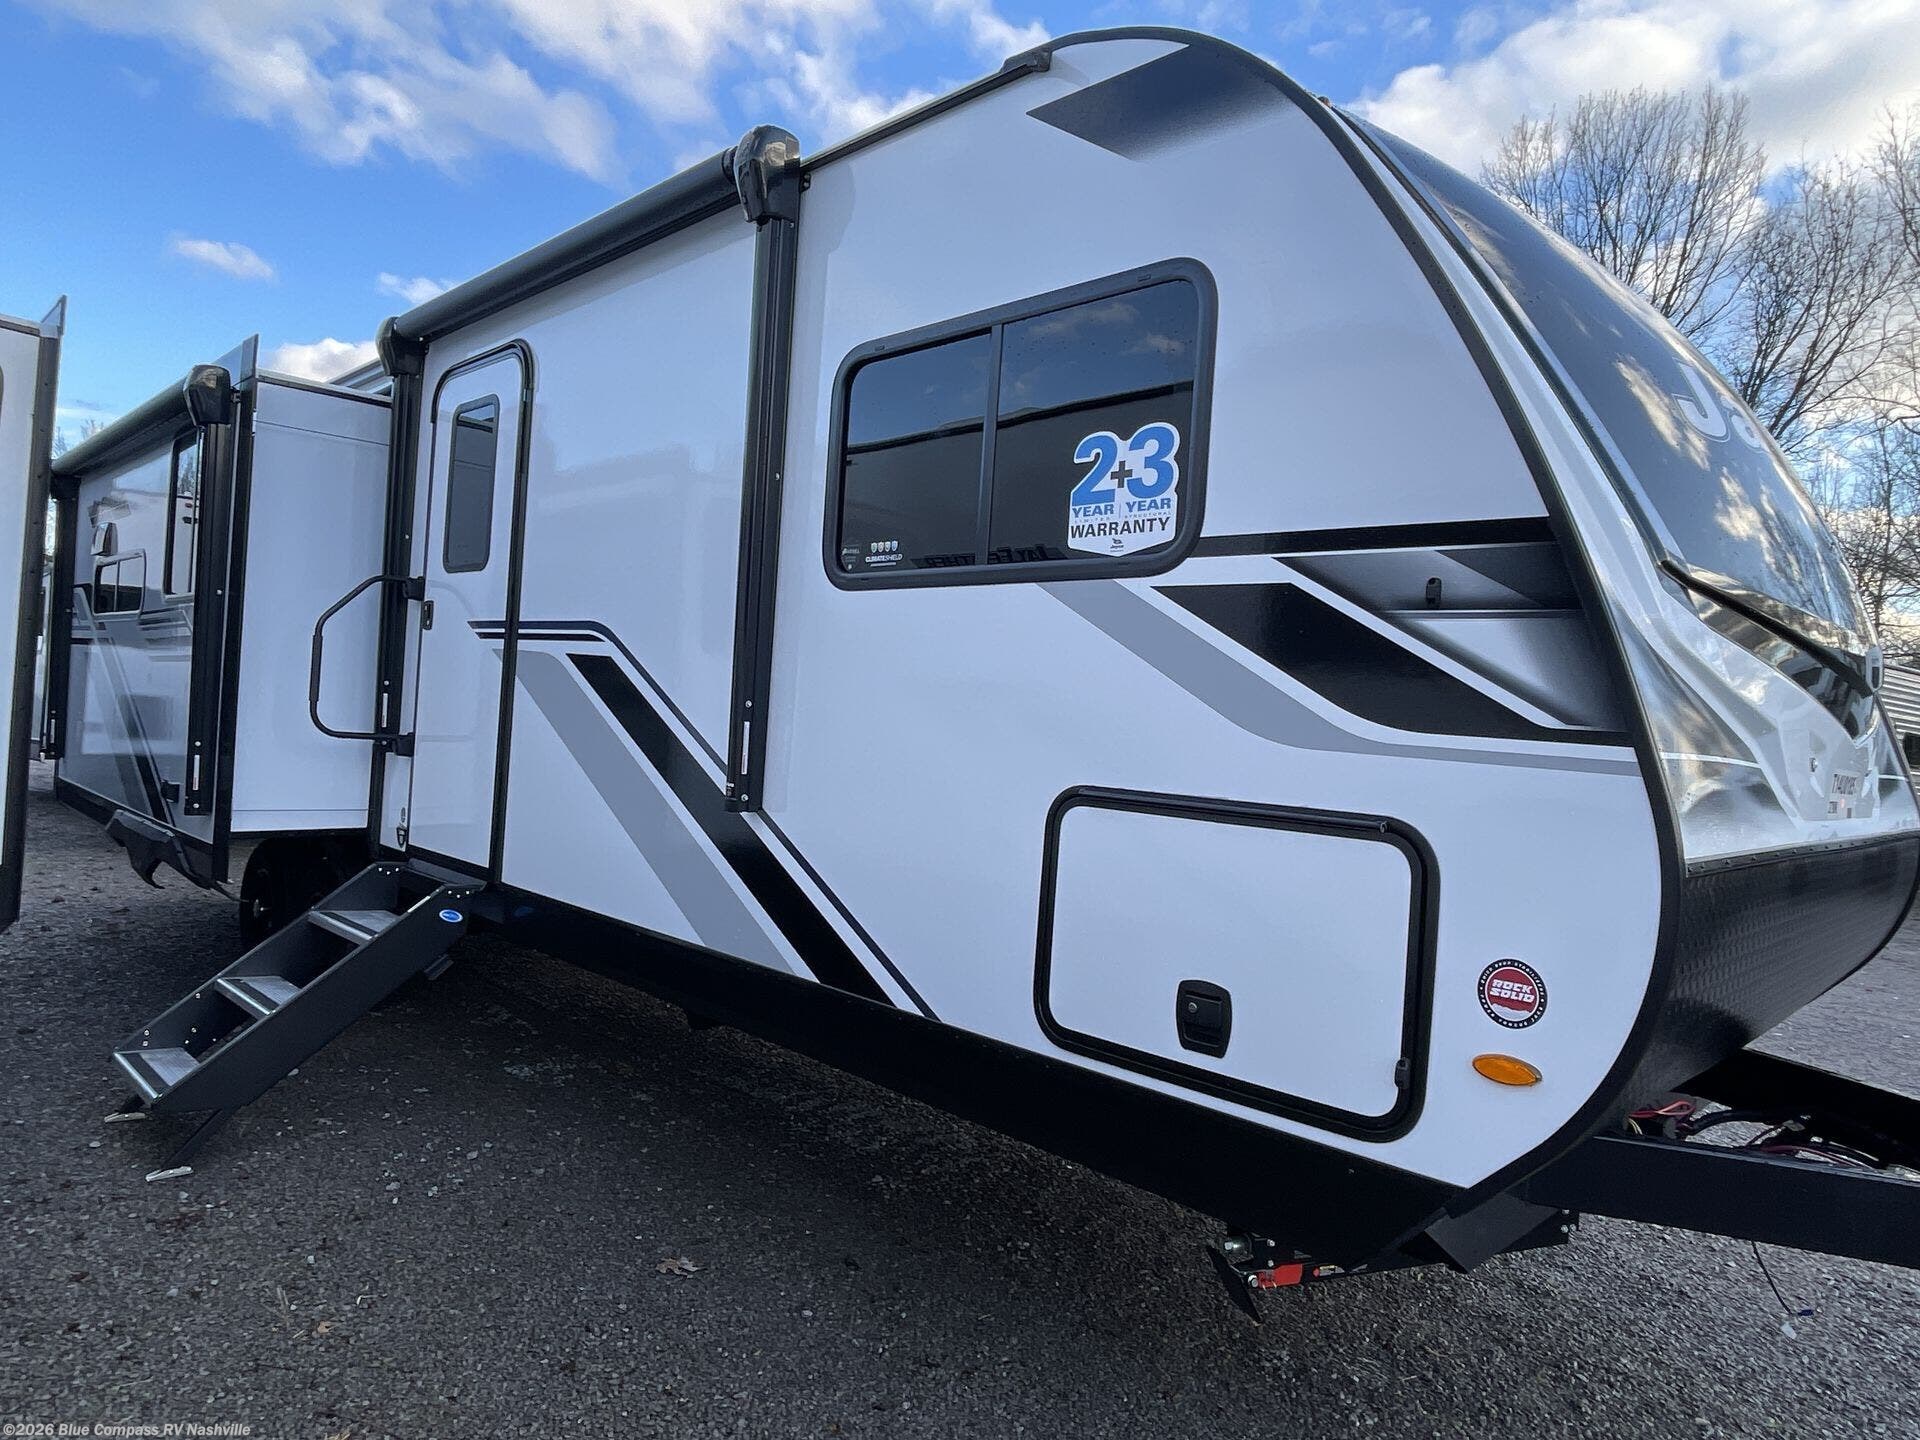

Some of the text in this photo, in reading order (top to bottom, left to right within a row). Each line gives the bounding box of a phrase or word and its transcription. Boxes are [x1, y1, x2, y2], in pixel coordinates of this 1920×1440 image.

[1072, 498, 1171, 518] YEAR YEAR
[1071, 517, 1170, 538] WARRANTY
[1489, 987, 1535, 1003] SOLID
[1492, 979, 1533, 994] ROCK
